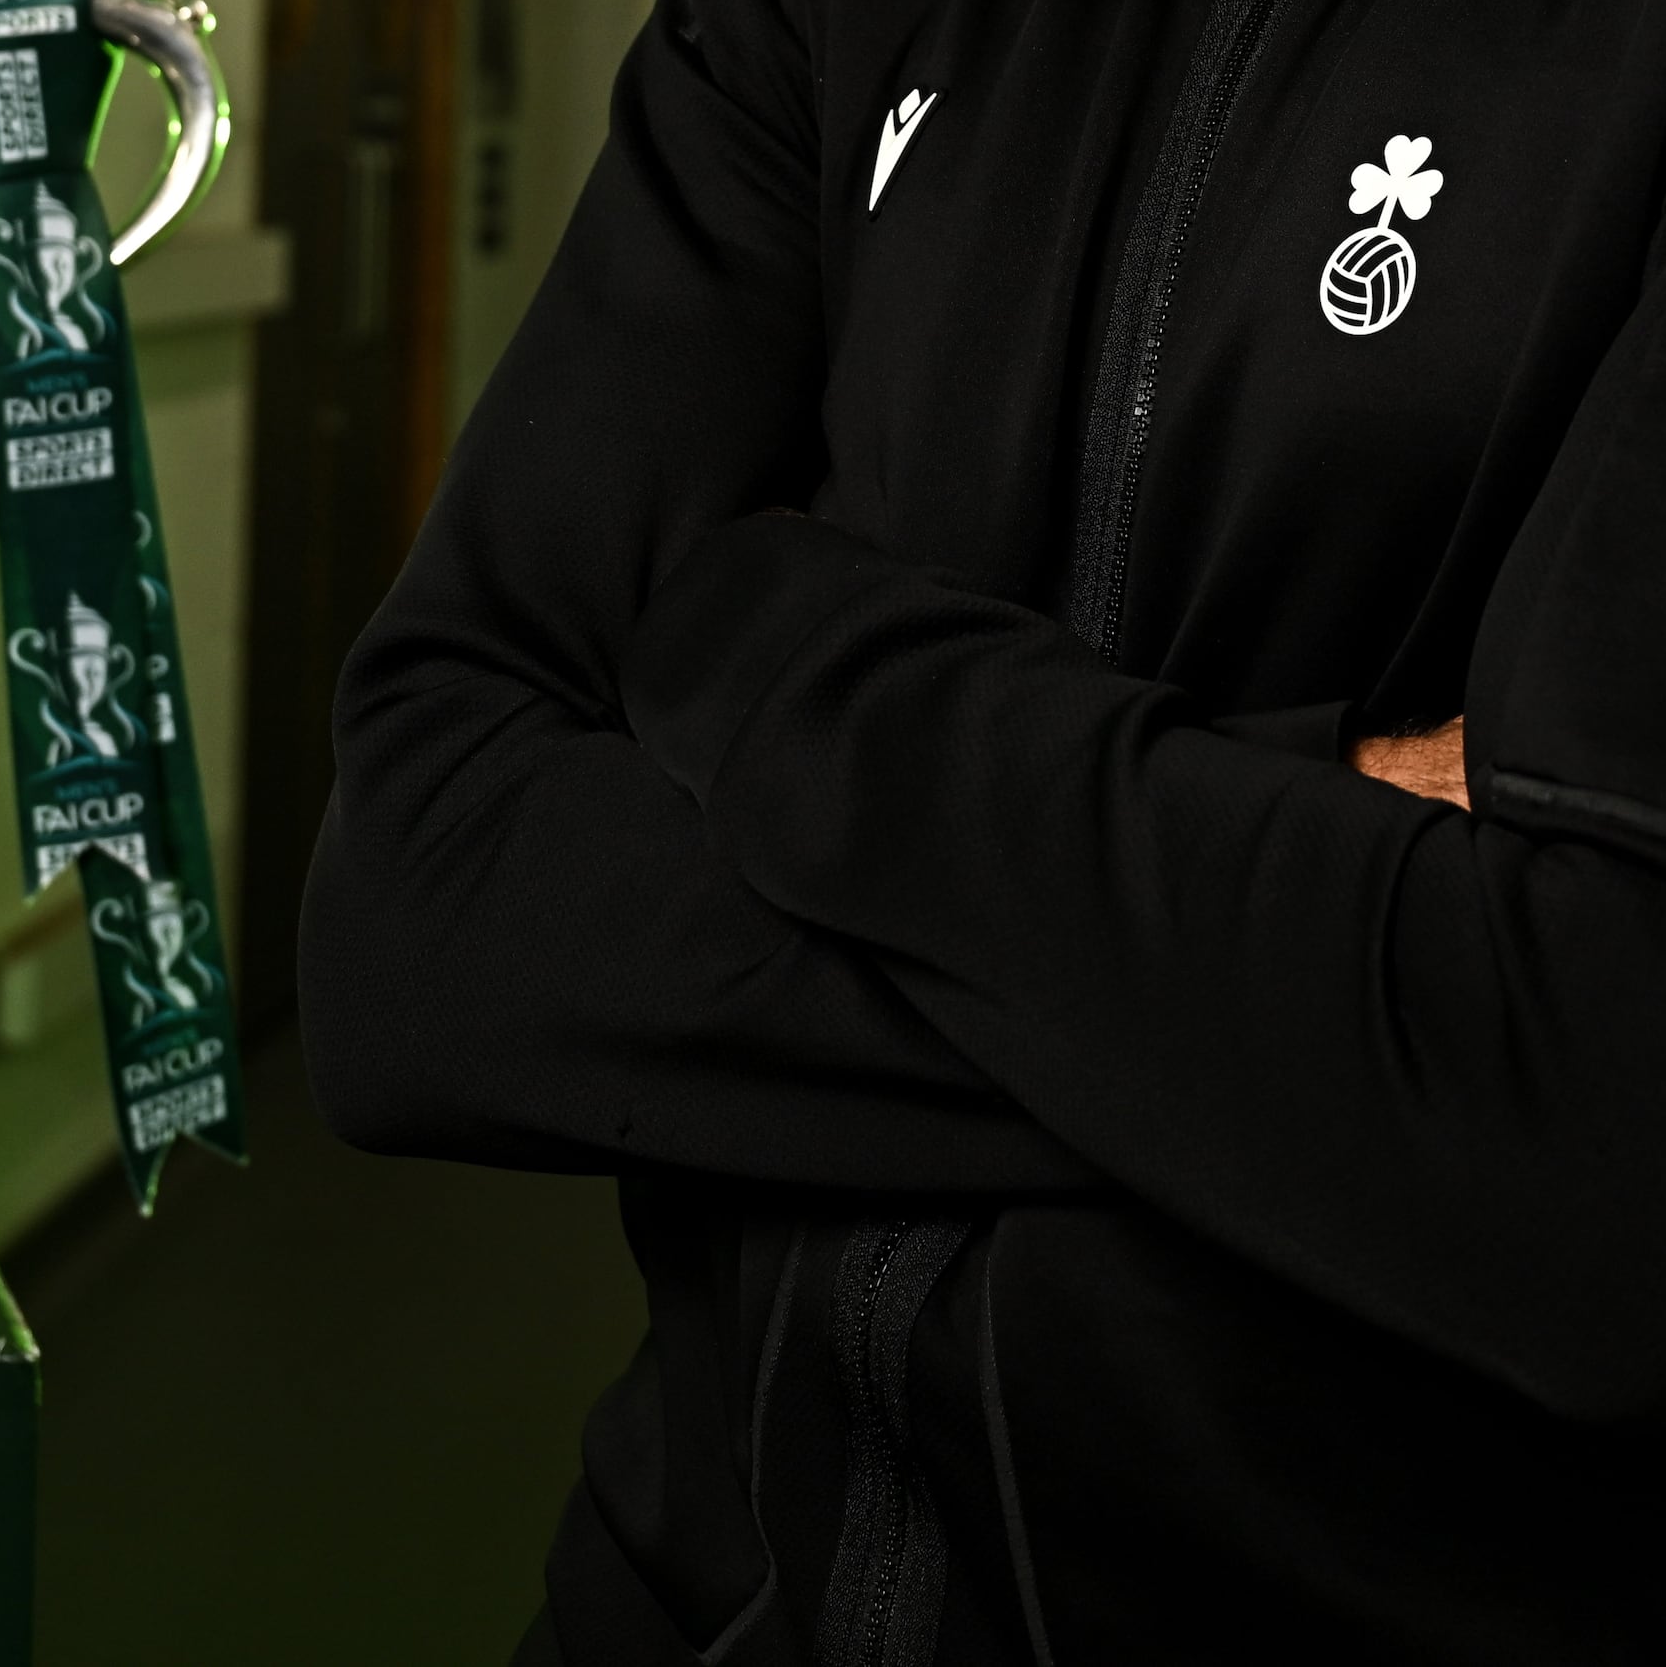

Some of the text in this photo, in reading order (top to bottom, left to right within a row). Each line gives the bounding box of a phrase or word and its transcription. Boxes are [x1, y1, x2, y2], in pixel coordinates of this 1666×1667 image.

[3, 387, 113, 428] FAI CUP
[16, 433, 102, 461] SPORTS
[17, 456, 103, 487] DIRECT
[33, 792, 144, 833] FAI CUP
[121, 1037, 224, 1092] FAI CUP
